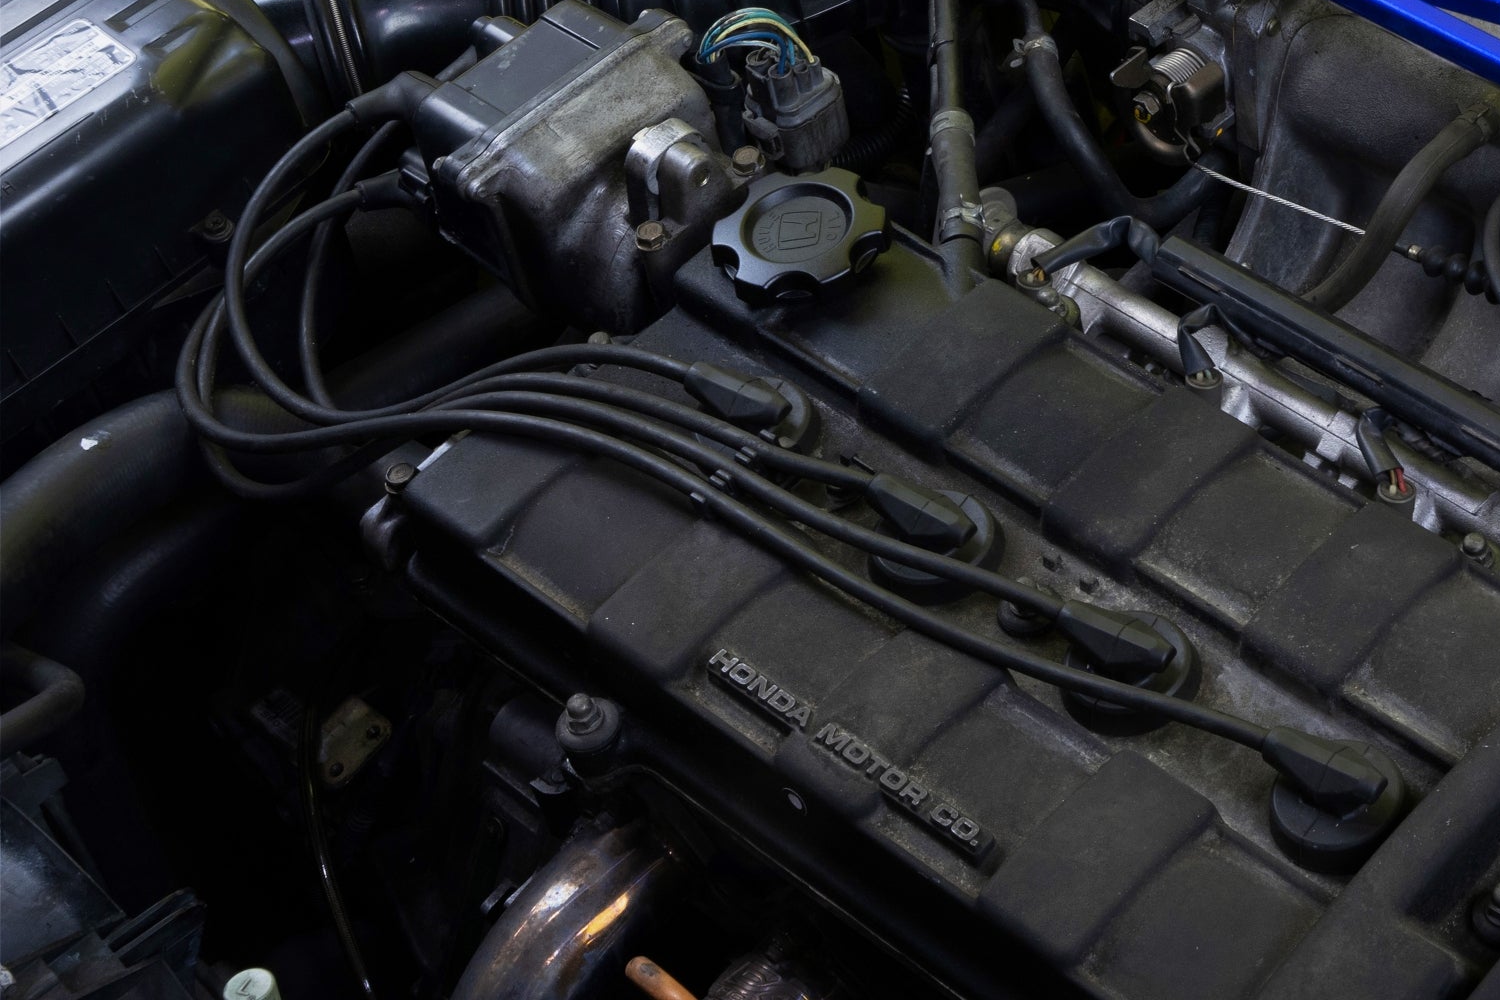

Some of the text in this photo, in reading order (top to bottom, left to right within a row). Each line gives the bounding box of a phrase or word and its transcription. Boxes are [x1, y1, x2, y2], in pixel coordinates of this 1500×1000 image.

[708, 648, 980, 847] HONDA MOTOR CO.
